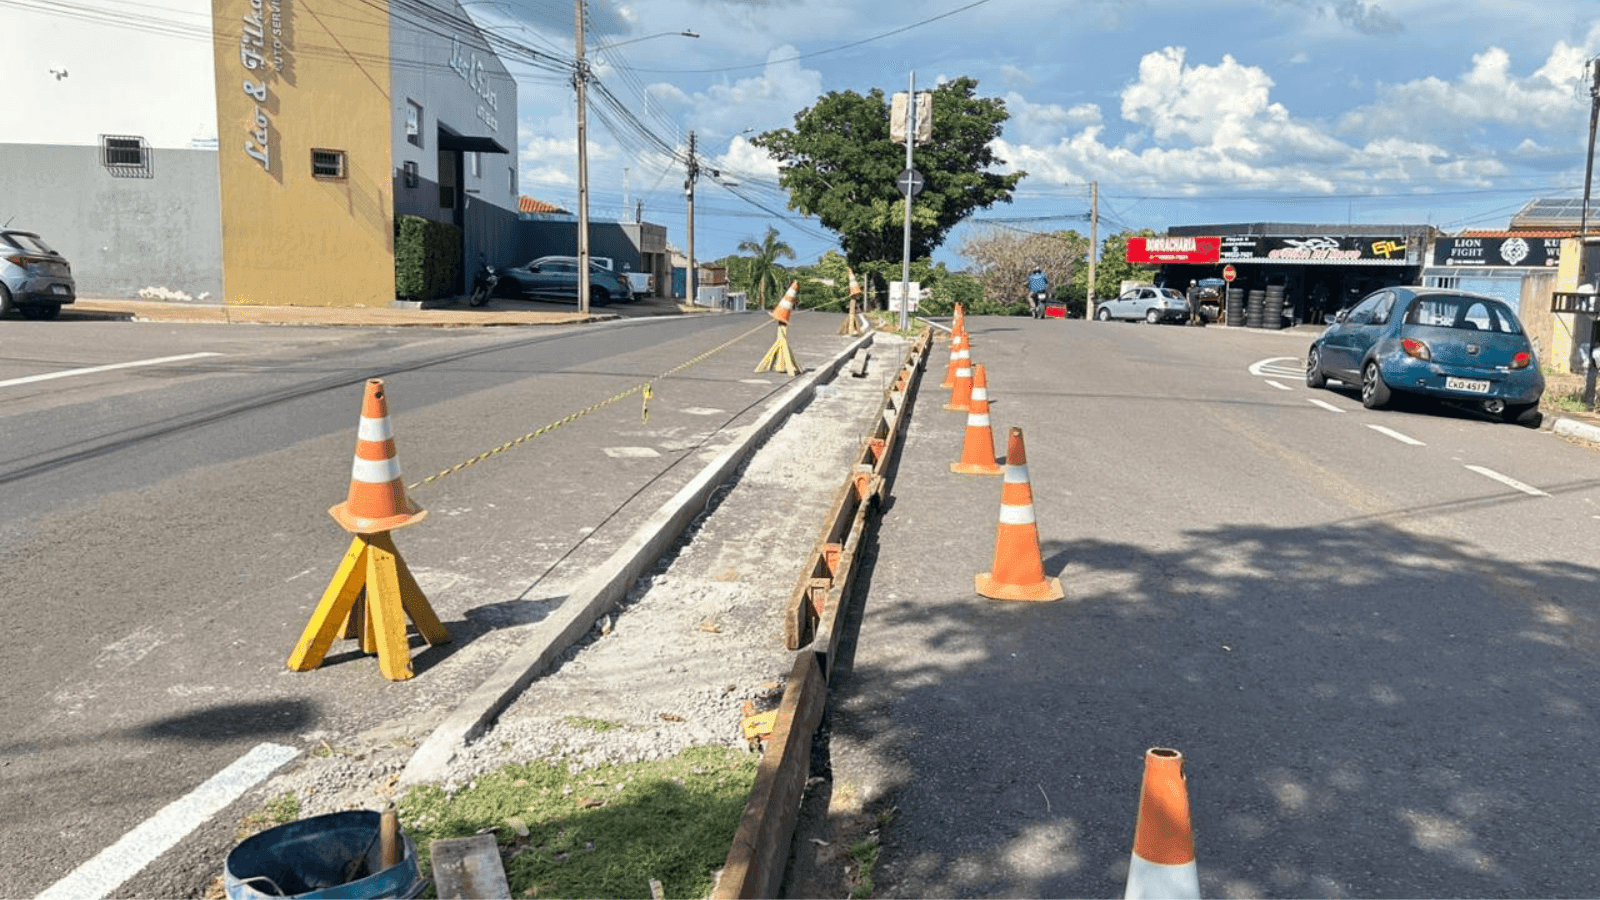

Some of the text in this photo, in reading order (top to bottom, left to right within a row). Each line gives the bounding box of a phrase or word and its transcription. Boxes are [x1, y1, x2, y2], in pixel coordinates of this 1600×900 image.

[273, 40, 285, 72] AUTO
[243, 80, 267, 101] &
[1145, 237, 1197, 252] BORRACHARIA
[1371, 240, 1407, 259] GIL
[1450, 247, 1484, 257] FIGHT
[1454, 239, 1482, 248] LION
